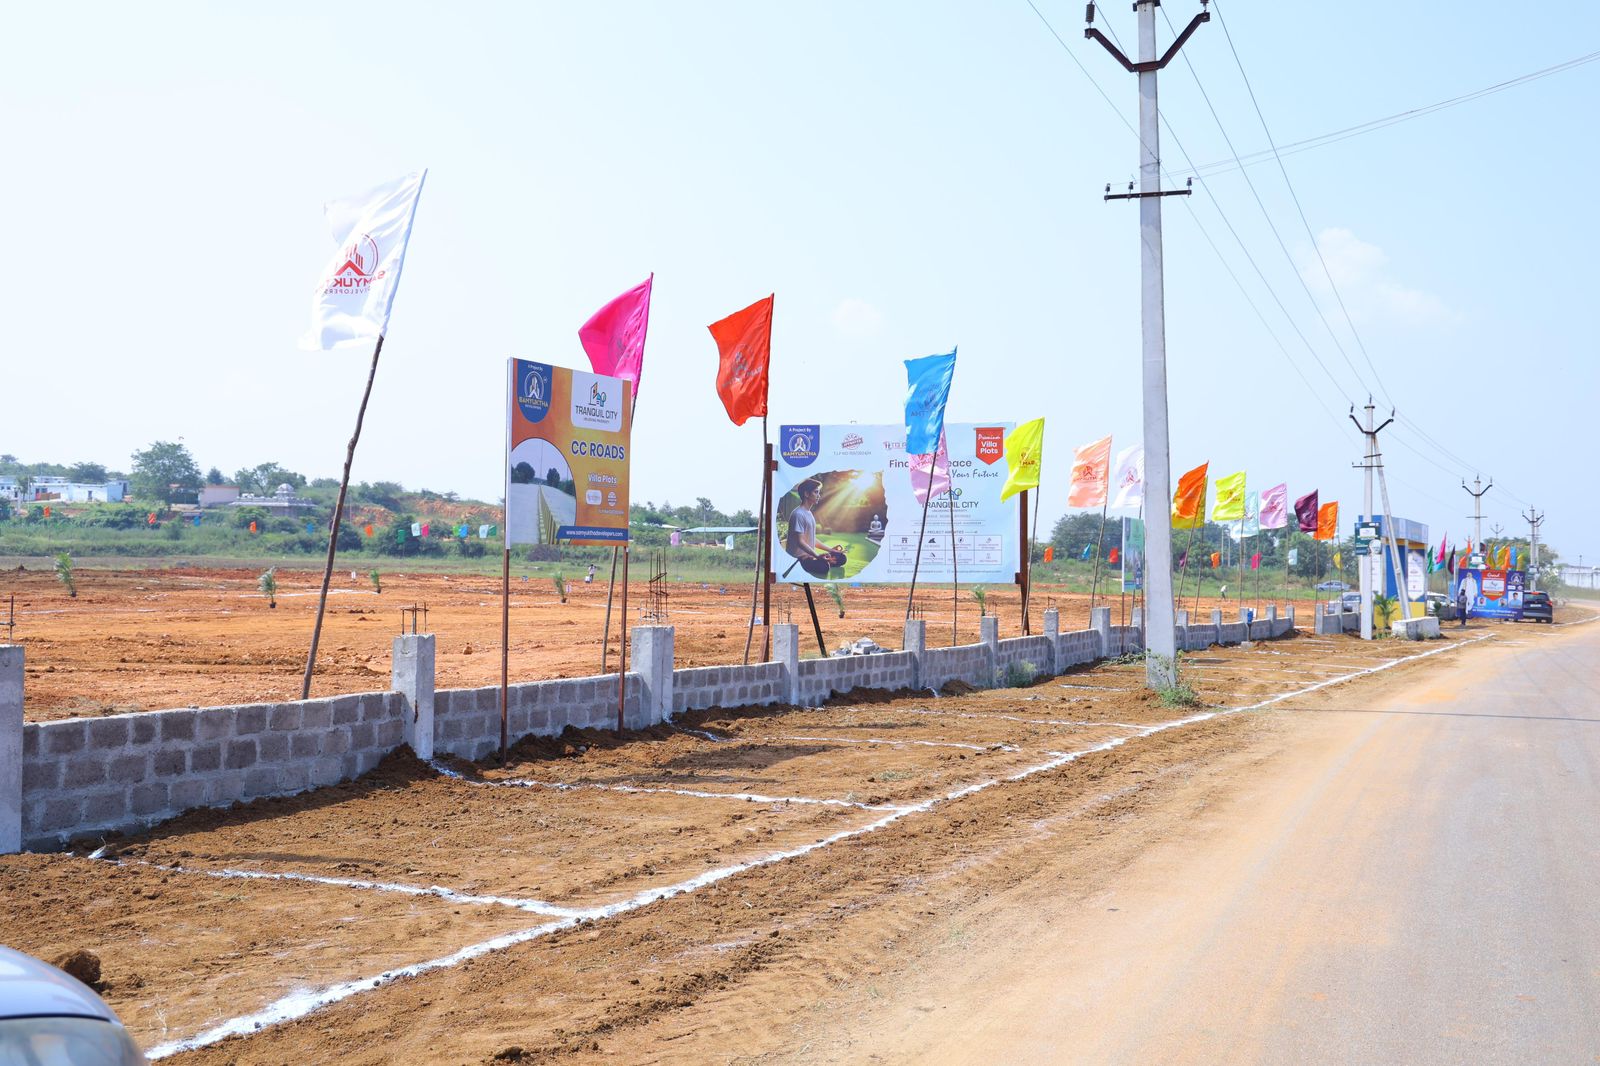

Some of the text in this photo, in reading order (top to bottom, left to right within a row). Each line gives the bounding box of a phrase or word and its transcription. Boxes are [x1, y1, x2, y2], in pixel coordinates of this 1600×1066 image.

[575, 405, 618, 420] TRANQUIL CITY
[571, 440, 625, 460] CC ROADS
[588, 473, 617, 484] Villa Plots
[951, 468, 999, 478] Your Future
[922, 501, 960, 509] TRANQUIL
